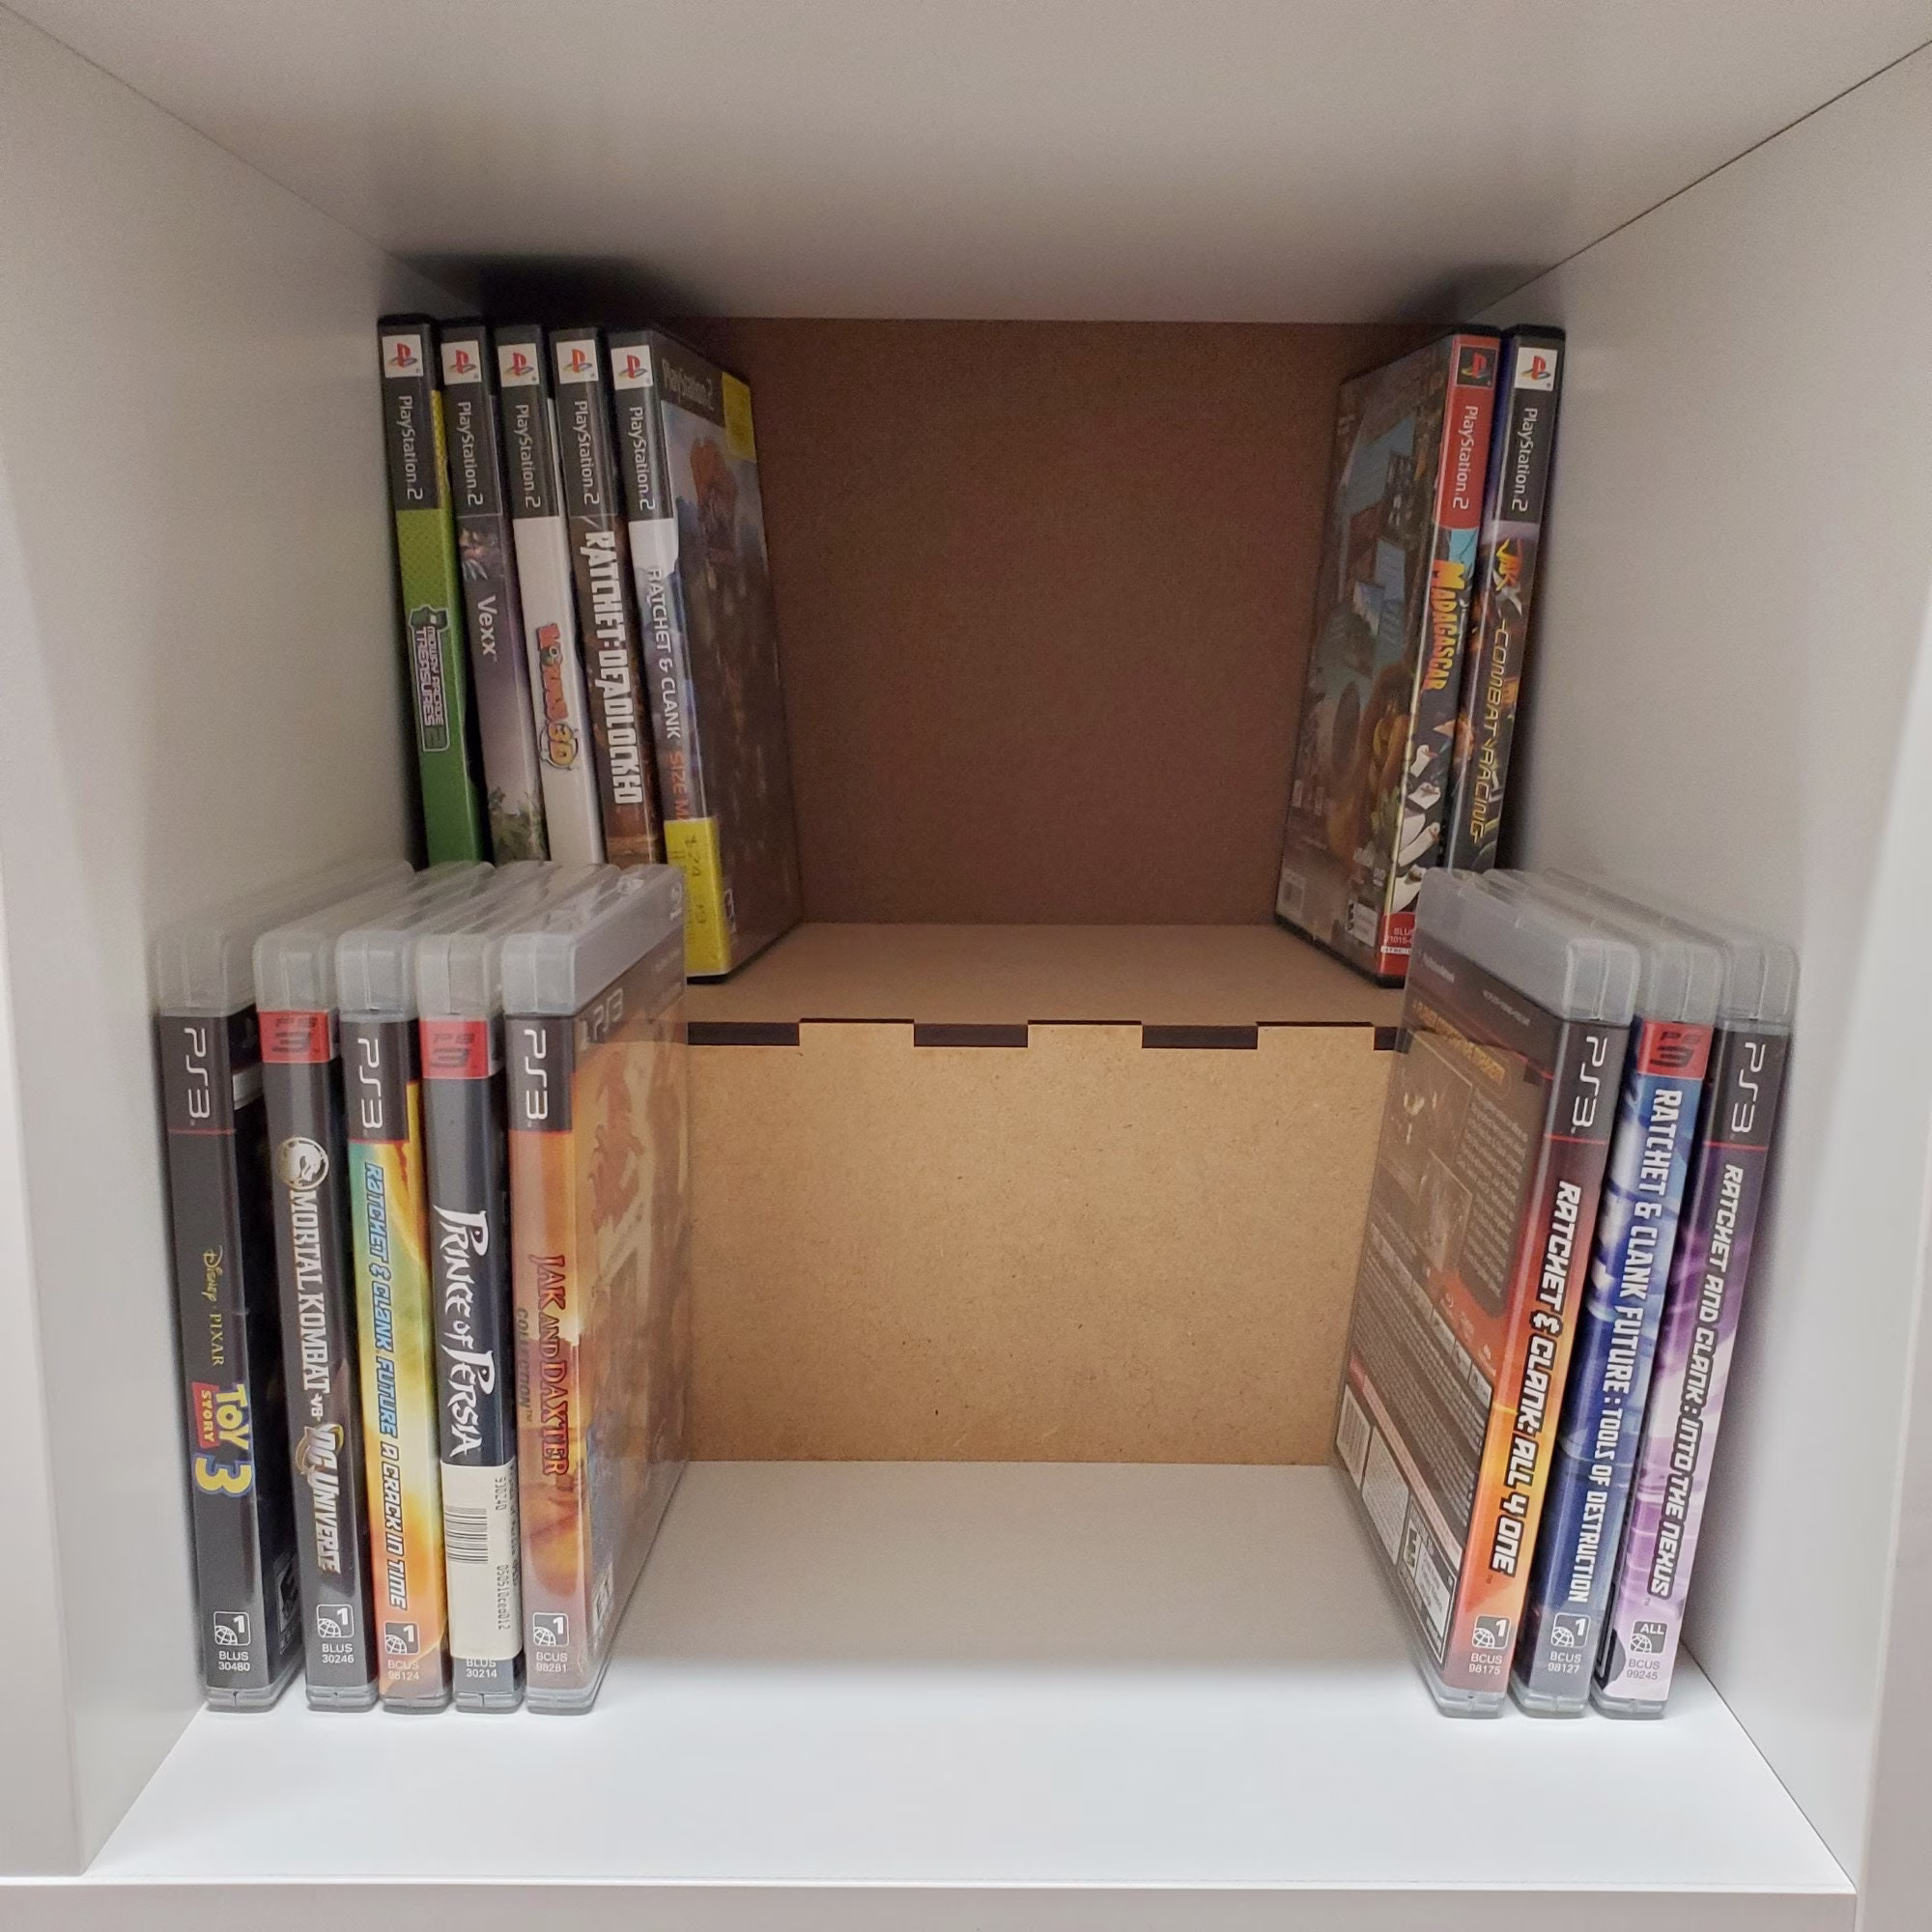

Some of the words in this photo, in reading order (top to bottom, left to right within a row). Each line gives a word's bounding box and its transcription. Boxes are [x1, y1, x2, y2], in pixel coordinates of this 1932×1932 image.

[477, 595, 497, 656] Vexx
[646, 566, 671, 653] RATCHET
[426, 626, 440, 673] MIDWAY
[658, 658, 673, 672] &
[415, 627, 436, 726] TREASURES
[432, 677, 444, 725] ARCADE
[661, 677, 681, 740] CLANK
[666, 751, 688, 794] SIZE
[185, 1028, 210, 1119] PS3
[357, 1037, 384, 1129] PS3
[525, 1029, 548, 1121] PS3
[1572, 1036, 1607, 1128] PS3
[1731, 1042, 1767, 1134] PS3
[1639, 1089, 1683, 1196] RATCHET
[1634, 1201, 1662, 1221] &
[1708, 1164, 1744, 1273] RATCHET
[290, 1190, 323, 1291] MORTAL
[1539, 1180, 1582, 1312] RATCHET
[1619, 1225, 1658, 1300] CLANK
[201, 1244, 224, 1302] Disney
[369, 1262, 392, 1282] &
[530, 1254, 566, 1311] JAK
[1698, 1274, 1724, 1323] AND
[210, 1314, 225, 1366] PIXAR
[298, 1292, 330, 1394] KOMBAT
[540, 1311, 560, 1359] AND
[1532, 1311, 1561, 1335] &
[376, 1355, 398, 1439] FUTURE
[1517, 1335, 1556, 1435] CLANK:
[201, 1389, 215, 1443] STORY
[214, 1382, 250, 1451] TOY
[539, 1359, 570, 1477] DAXTER
[1594, 1407, 1623, 1462] TOOLS
[381, 1440, 399, 1463] A
[1507, 1436, 1537, 1487] ALL
[1673, 1417, 1700, 1472] INTO
[195, 1456, 252, 1494] 3
[382, 1461, 404, 1534] CRACK
[1588, 1463, 1612, 1488] OF
[1665, 1474, 1690, 1520] THE
[307, 1471, 341, 1575] UNIVERSE
[1502, 1493, 1527, 1516] 4
[385, 1533, 405, 1556] IN
[1492, 1516, 1522, 1576] ONE
[1568, 1491, 1607, 1604] DESTRUCTION
[1650, 1520, 1681, 1597] NEXUS
[387, 1558, 408, 1611] TIME
[234, 1615, 245, 1633] 1
[337, 1607, 349, 1625] 1
[403, 1625, 414, 1642] 1
[553, 1616, 564, 1634] 1
[1495, 1618, 1508, 1637] 1
[1576, 1618, 1587, 1636] 1
[1640, 1623, 1664, 1634] ALL
[218, 1651, 249, 1661] BLUS
[322, 1643, 353, 1653] BLUS
[387, 1659, 419, 1670] BCUS
[467, 1658, 497, 1667] BLUS
[536, 1651, 568, 1662] BCUS
[1468, 1663, 1501, 1675] 98175
[1470, 1653, 1502, 1664] BCUS
[1548, 1663, 1580, 1674] 98127
[1549, 1651, 1582, 1663] BCUS
[1629, 1659, 1661, 1669] BCUS
[466, 1668, 497, 1678] 30214
[1626, 1669, 1659, 1680] 99245
